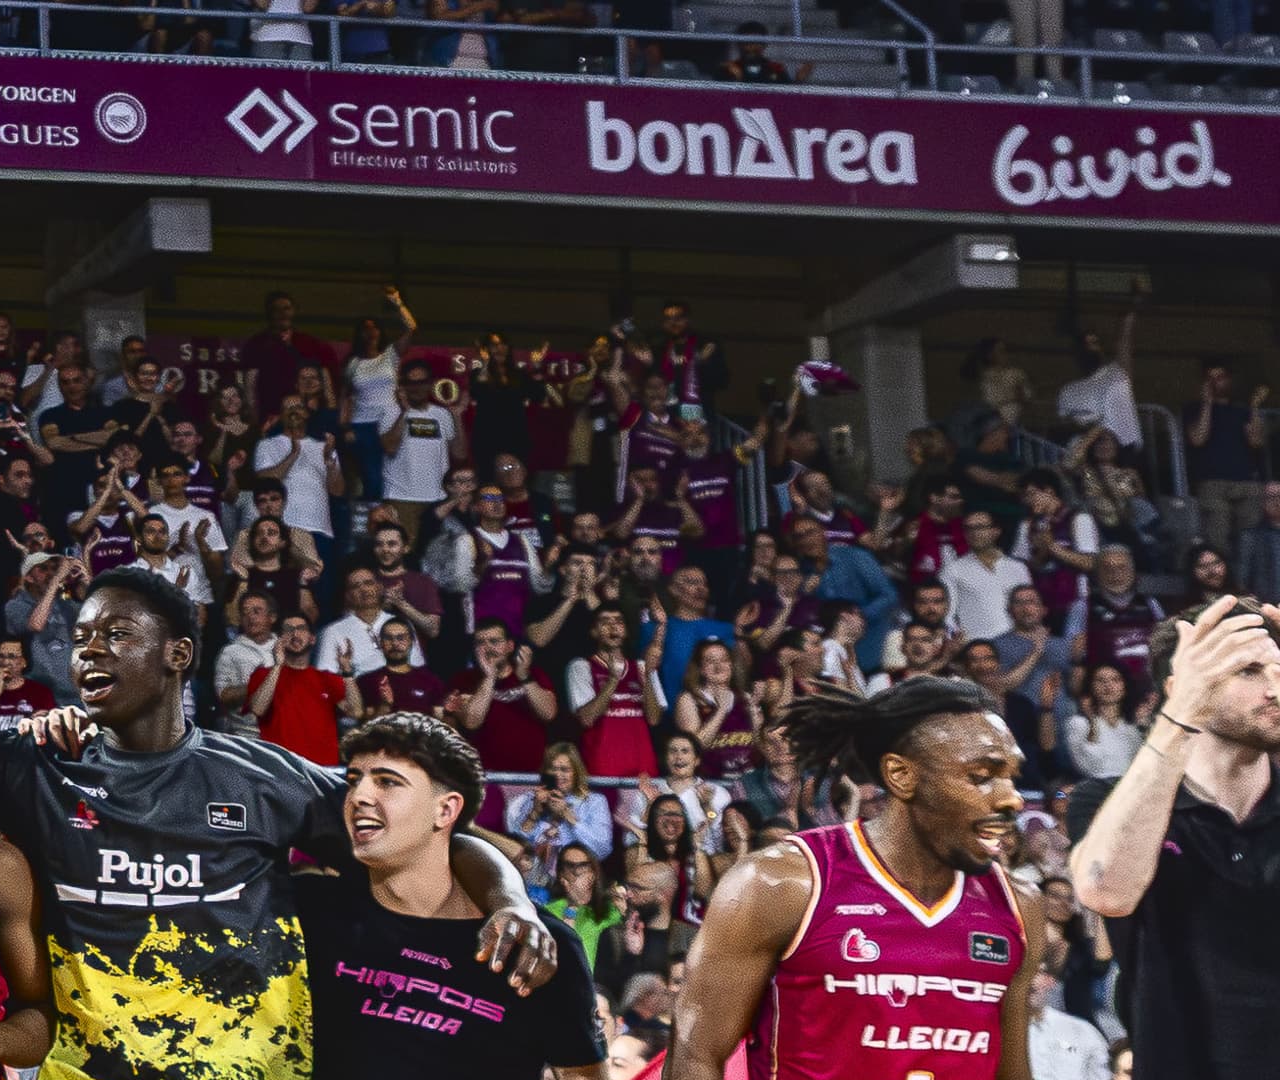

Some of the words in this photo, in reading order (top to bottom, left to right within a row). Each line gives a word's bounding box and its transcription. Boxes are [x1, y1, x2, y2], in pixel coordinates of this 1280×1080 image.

[330, 98, 516, 154] semic
[331, 151, 407, 167] Effective
[435, 157, 519, 176] Solutions
[98, 848, 204, 894] Pujol
[336, 960, 505, 1023] HIOPOS
[824, 973, 1005, 1003] HIOPOS
[360, 998, 463, 1036] LLEIDA
[861, 1024, 990, 1054] LLEIDA
